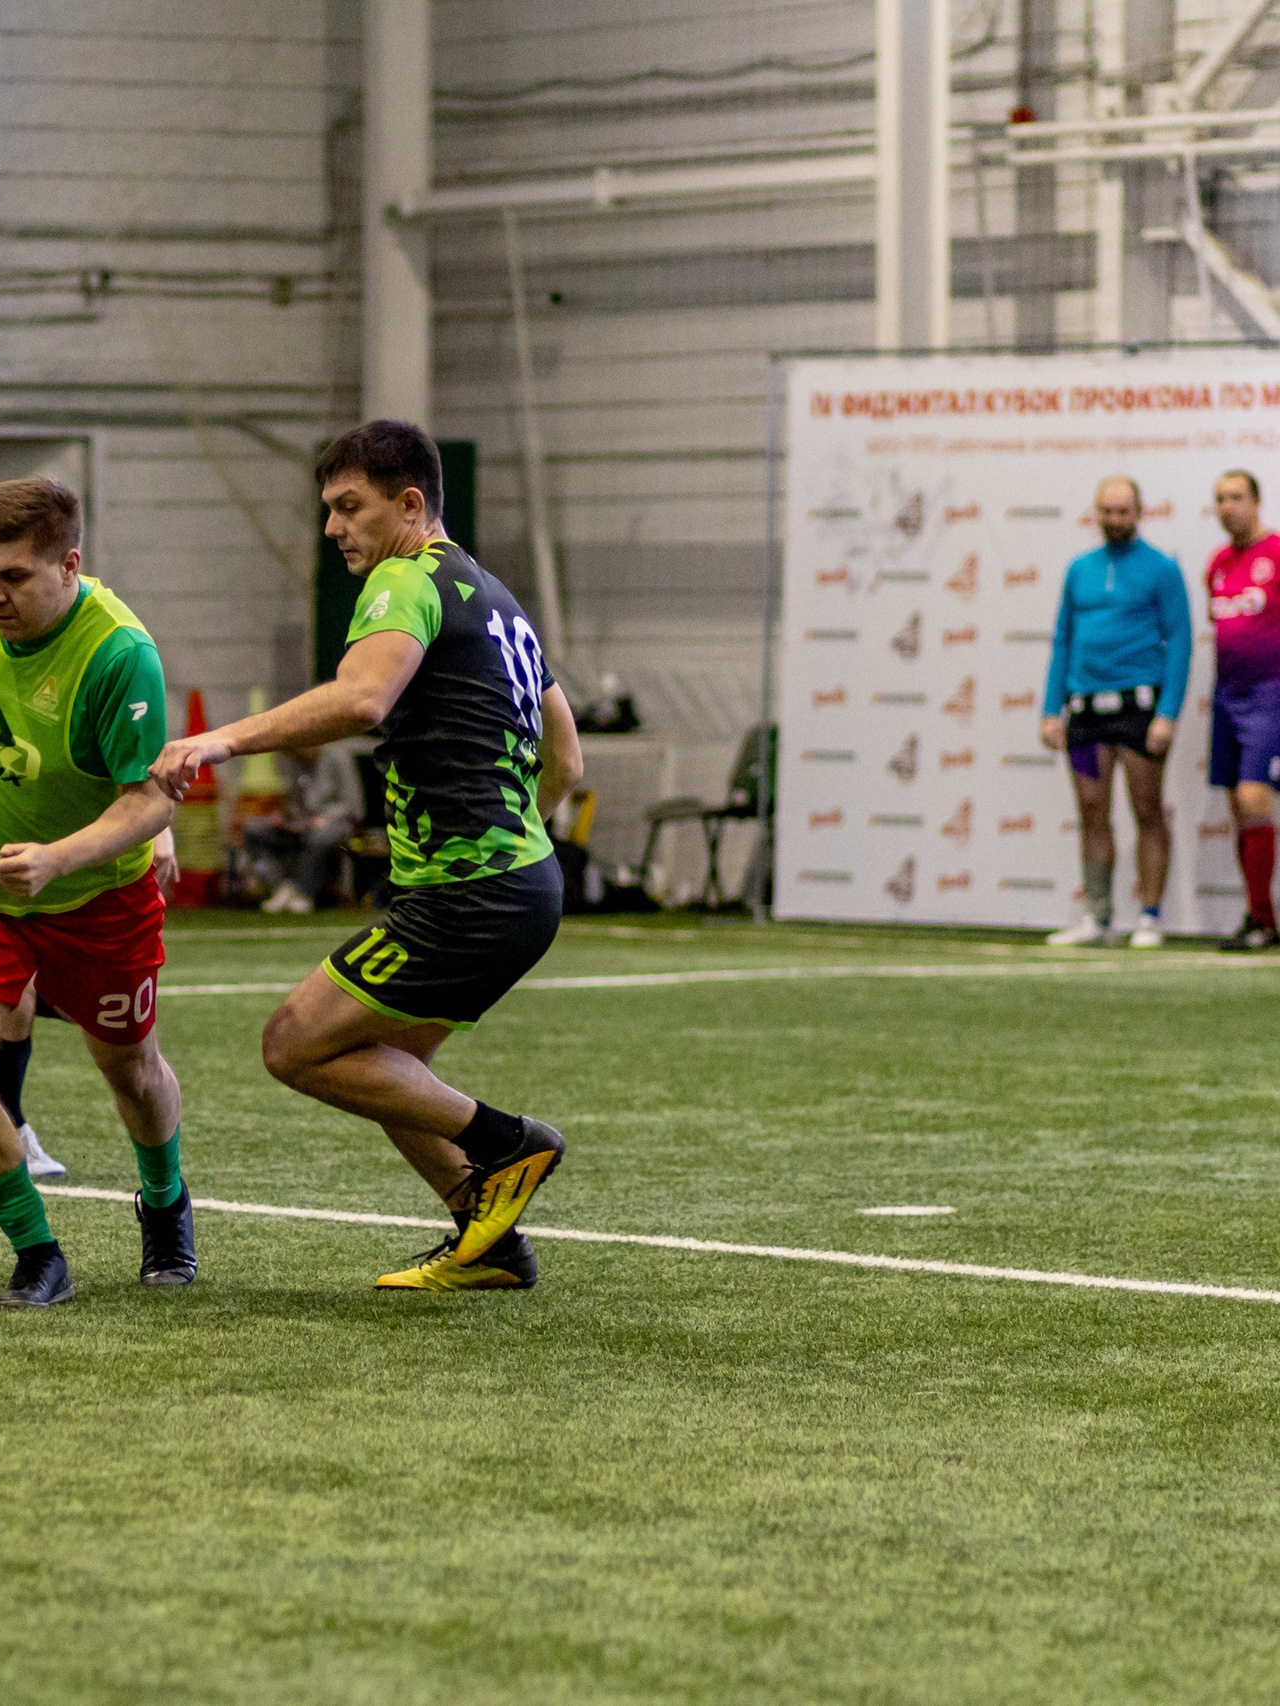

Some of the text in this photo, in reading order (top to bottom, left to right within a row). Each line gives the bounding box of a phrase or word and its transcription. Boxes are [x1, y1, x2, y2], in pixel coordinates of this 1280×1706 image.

[979, 389, 1062, 415] КУБОК
[1070, 386, 1214, 414] ПРОФКОМА
[1220, 383, 1255, 411] ПО
[487, 609, 544, 741] 10
[344, 926, 409, 986] 10
[96, 976, 153, 1029] 20
